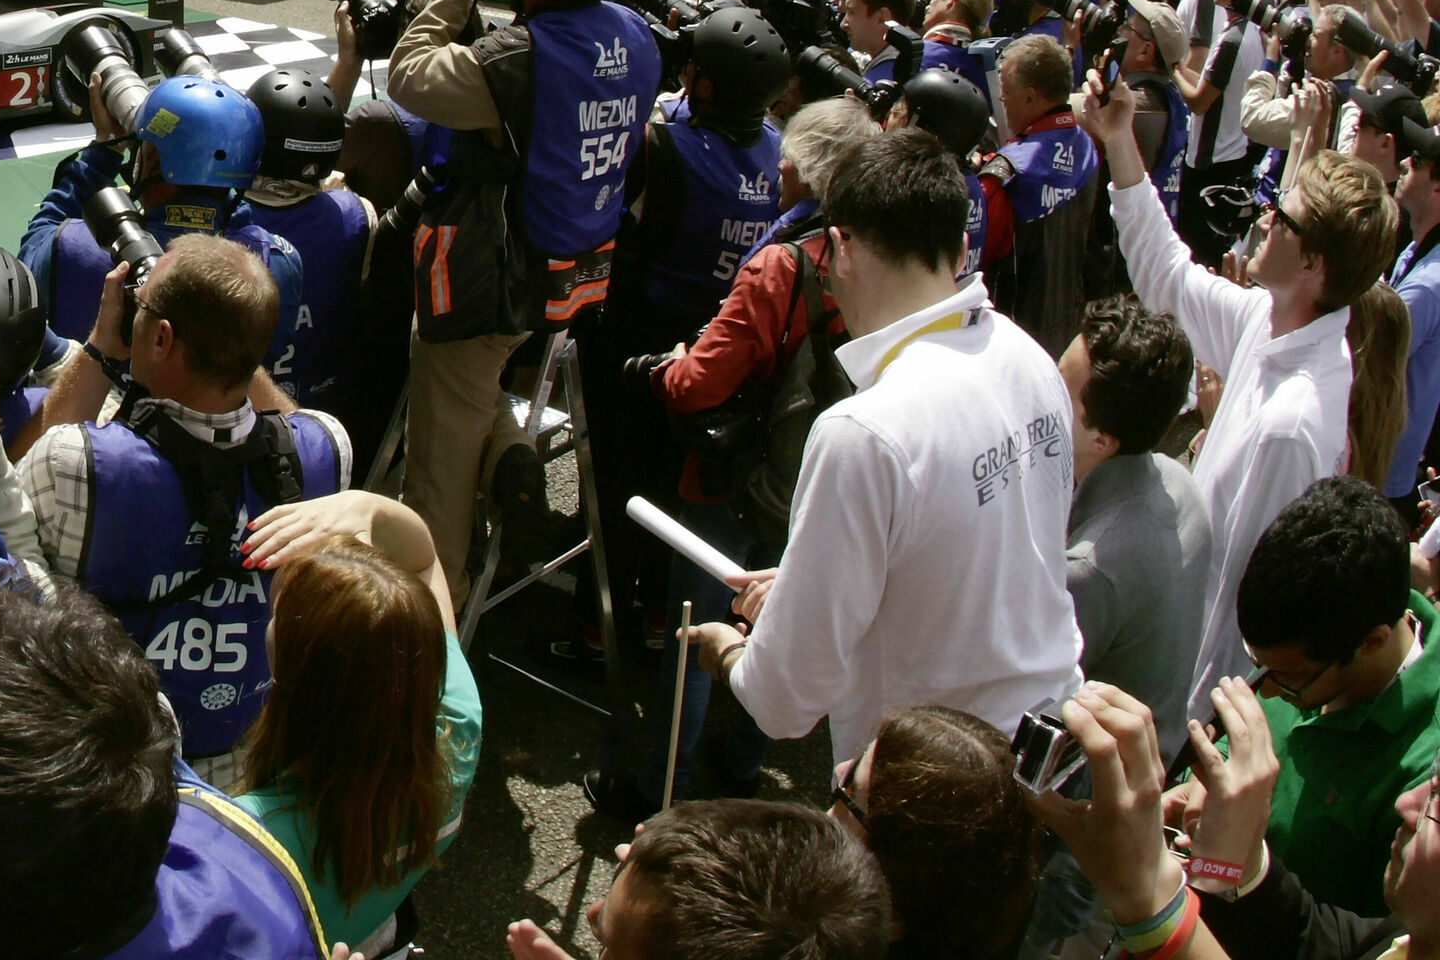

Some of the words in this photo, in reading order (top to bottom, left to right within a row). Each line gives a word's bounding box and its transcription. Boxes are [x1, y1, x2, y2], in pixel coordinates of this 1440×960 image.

[30, 53, 49, 61] MANS
[594, 36, 628, 68] 24h
[593, 67, 606, 77] LE
[606, 64, 629, 76] MANS
[10, 71, 32, 107] 2
[578, 95, 637, 132] MEDIA
[1055, 115, 1073, 124] EOS
[580, 131, 630, 181] 554
[1053, 141, 1074, 167] 24h
[738, 171, 770, 195] 24h
[972, 430, 1021, 482] GRAND
[184, 533, 204, 545] LE
[144, 617, 249, 673] 485
[1203, 862, 1226, 875] ACO
